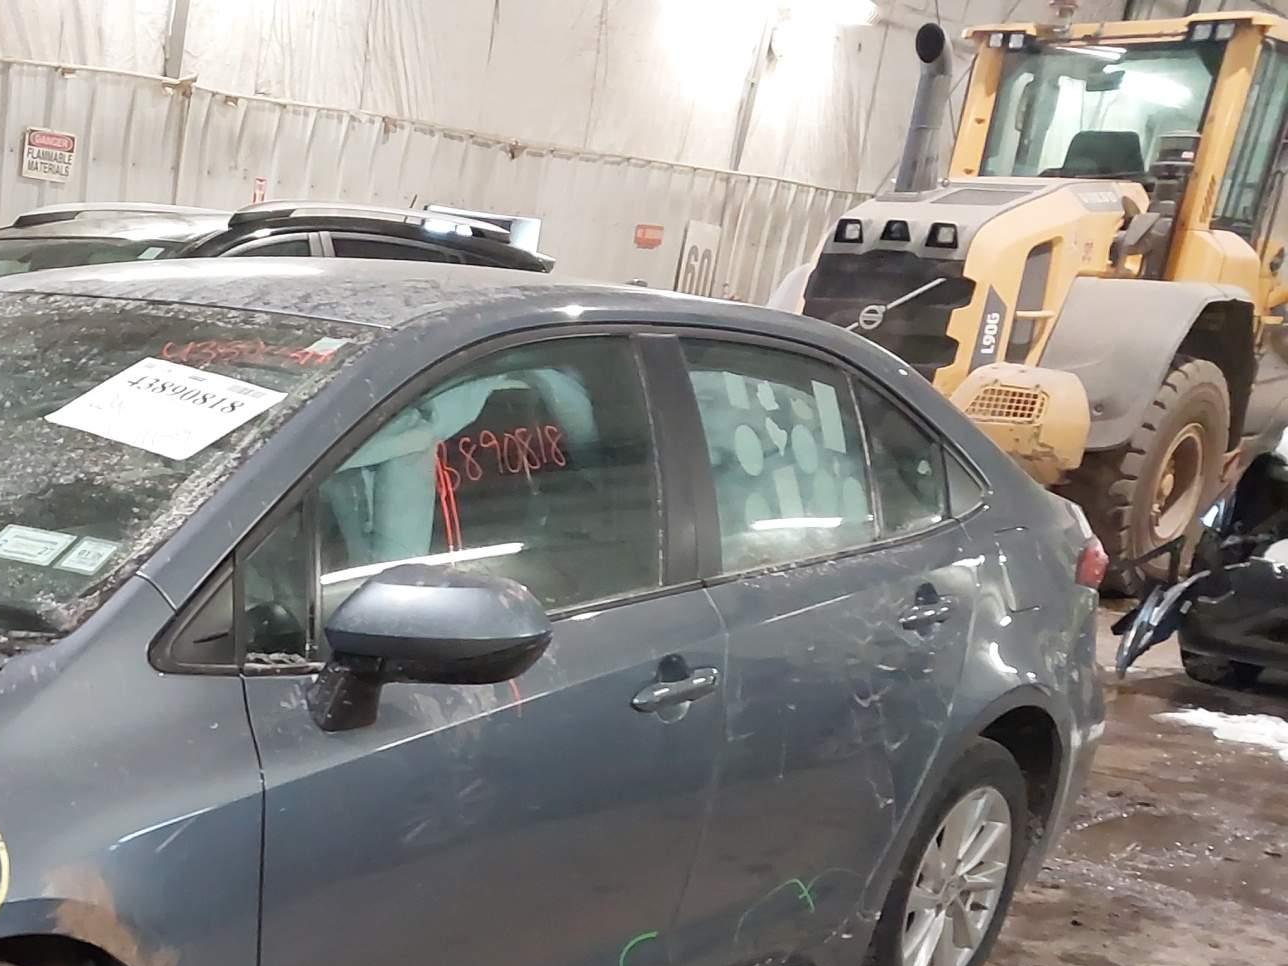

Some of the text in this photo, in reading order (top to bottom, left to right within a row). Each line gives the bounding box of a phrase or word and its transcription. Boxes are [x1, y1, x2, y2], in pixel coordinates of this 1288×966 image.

[33, 134, 69, 149] DANGER
[27, 147, 72, 165] FLAMMABLE
[27, 159, 69, 177] MATERIALS
[980, 312, 1000, 354] L90G
[128, 376, 245, 414] 43890818
